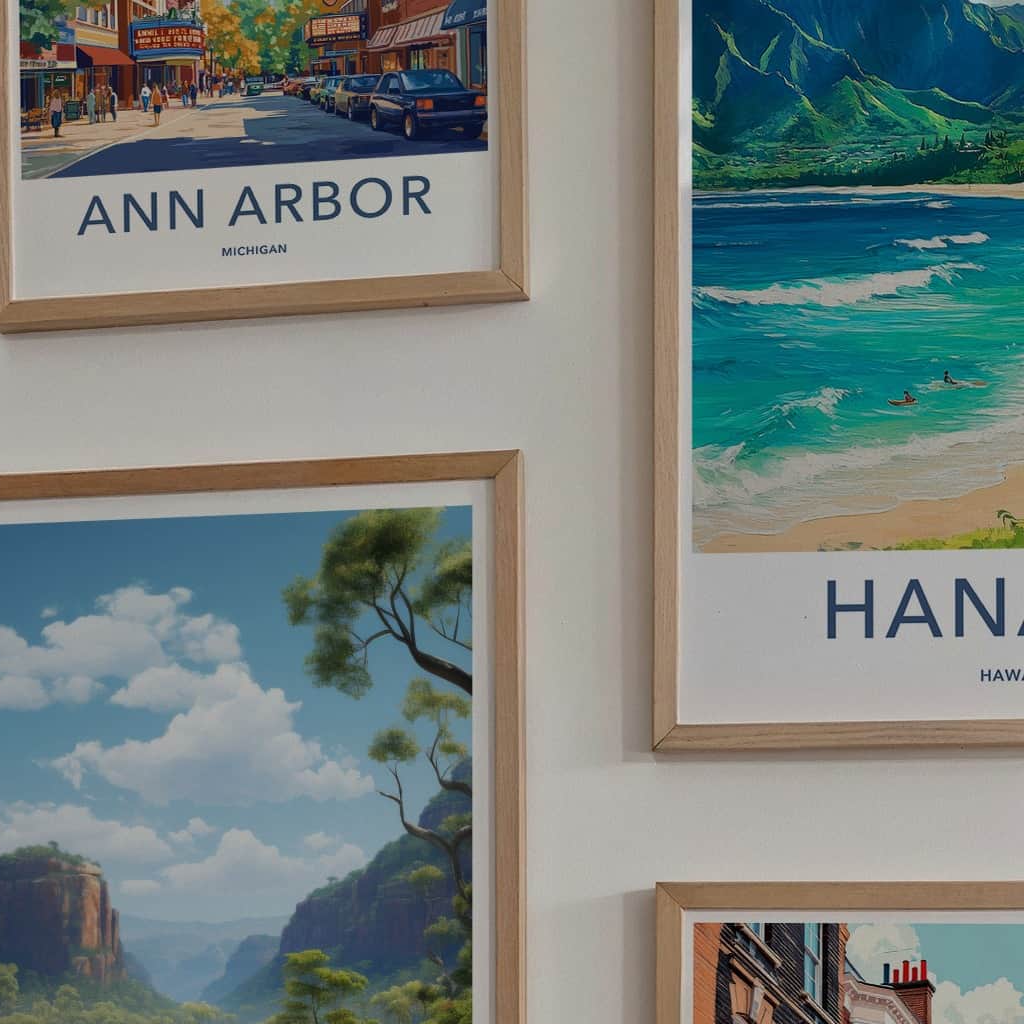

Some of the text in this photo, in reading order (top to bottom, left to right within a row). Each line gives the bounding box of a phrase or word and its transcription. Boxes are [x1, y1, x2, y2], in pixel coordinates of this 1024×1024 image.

[77, 175, 433, 236] ANN ARBOR
[221, 244, 288, 257] MICHIGAN
[826, 577, 1024, 640] HAN
[980, 668, 1024, 682] HAW
